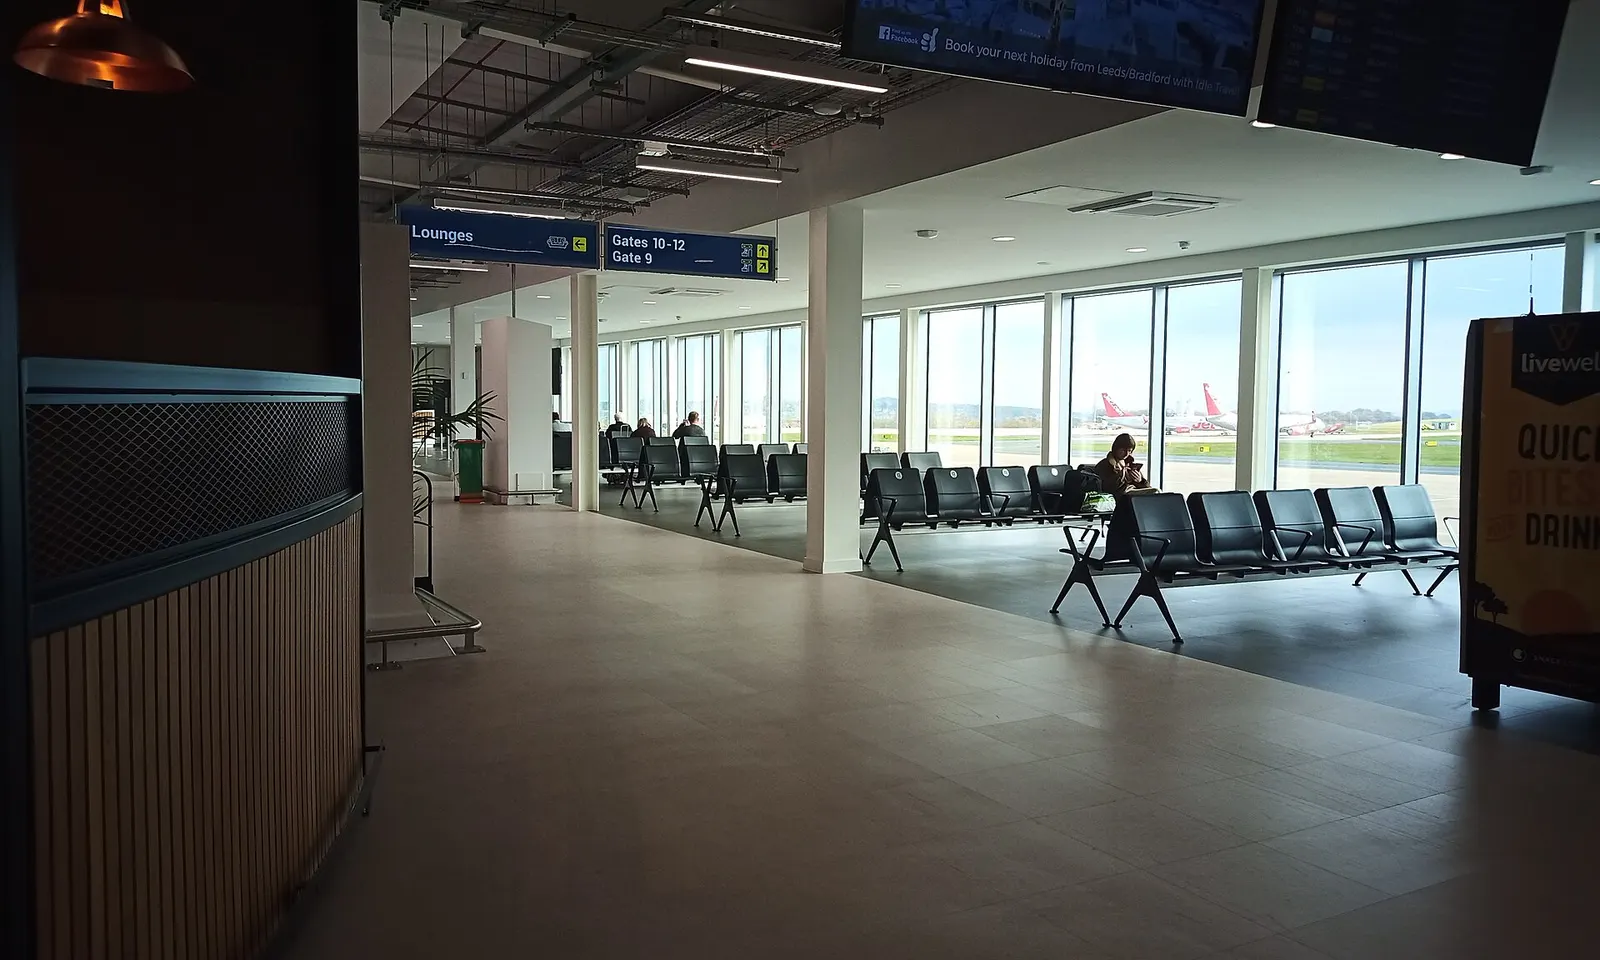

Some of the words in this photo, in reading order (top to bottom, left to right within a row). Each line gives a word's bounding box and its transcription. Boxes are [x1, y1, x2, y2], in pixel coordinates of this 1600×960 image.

[891, 34, 919, 44] Facebook
[945, 38, 974, 54] Book
[976, 44, 1001, 58] your
[1003, 49, 1027, 63] next
[1029, 51, 1068, 71] holiday
[1070, 58, 1095, 73] from
[1097, 63, 1172, 85] Leeds/Bradford
[1173, 75, 1194, 88] with
[412, 225, 474, 243] Lounges
[612, 233, 649, 249] Gates
[652, 237, 686, 251] 10-12
[612, 249, 642, 264] Gate
[645, 253, 653, 265] 9
